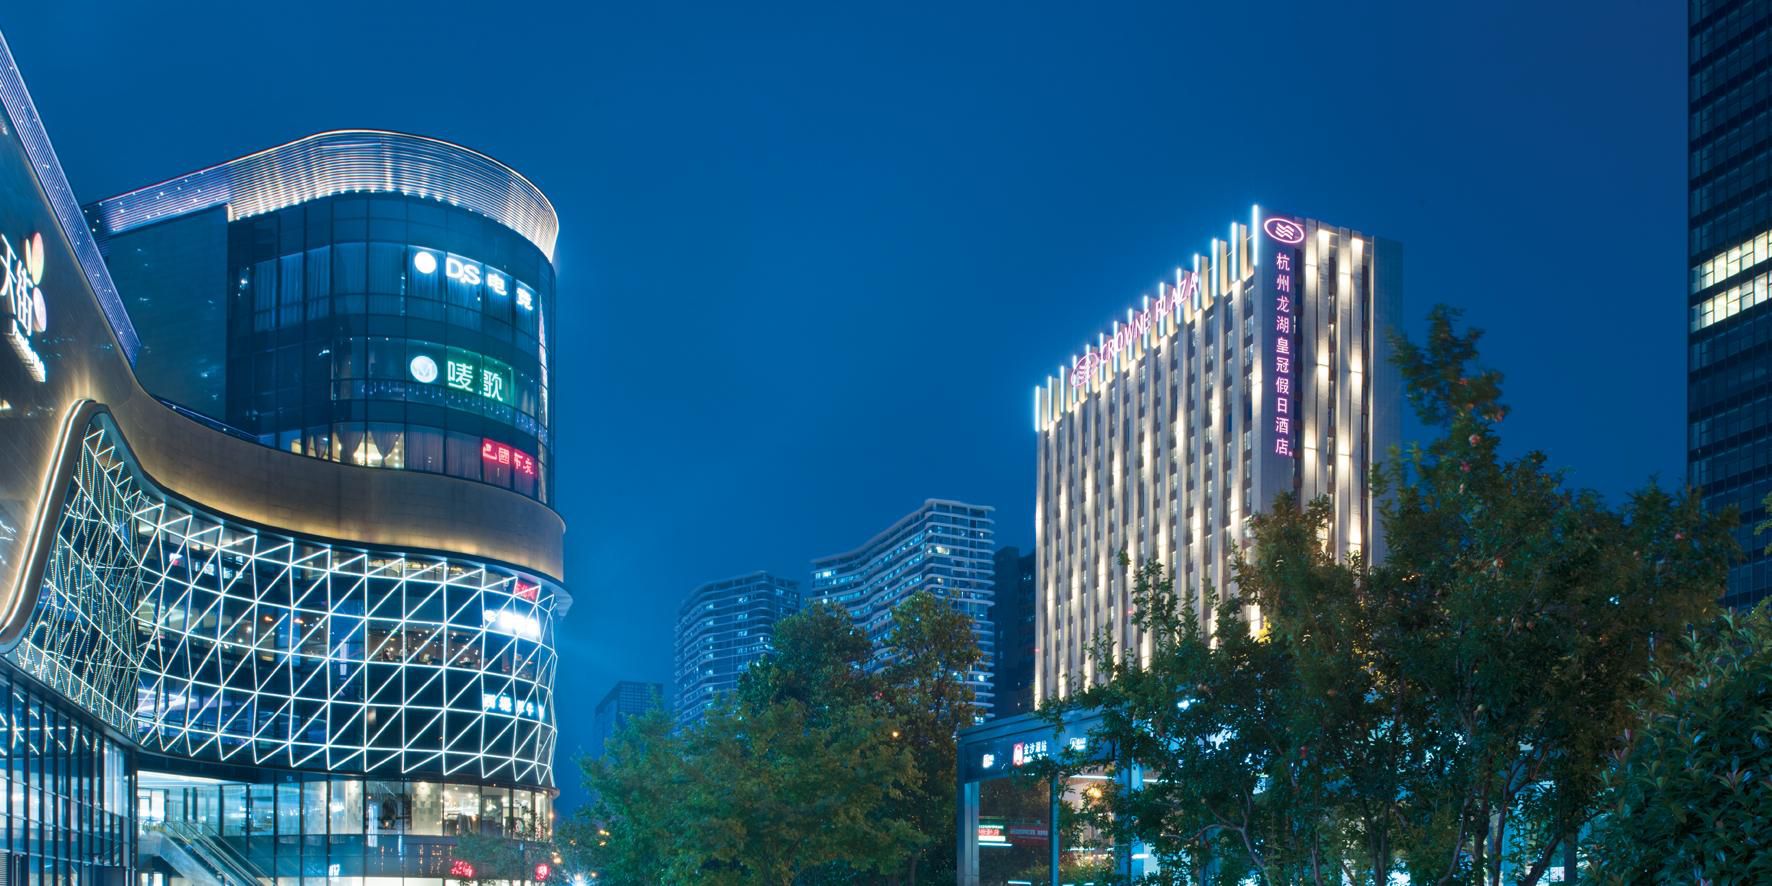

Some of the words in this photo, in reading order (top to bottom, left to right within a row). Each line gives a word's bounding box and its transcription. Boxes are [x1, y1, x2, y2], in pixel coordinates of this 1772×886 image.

[0, 233, 34, 337] 天街
[1101, 309, 1152, 363] CROWNE
[1155, 272, 1199, 322] PLAZA
[447, 361, 503, 401] 唛歌
[1275, 252, 1291, 455] 杭州龙湖皇冠假日酒店
